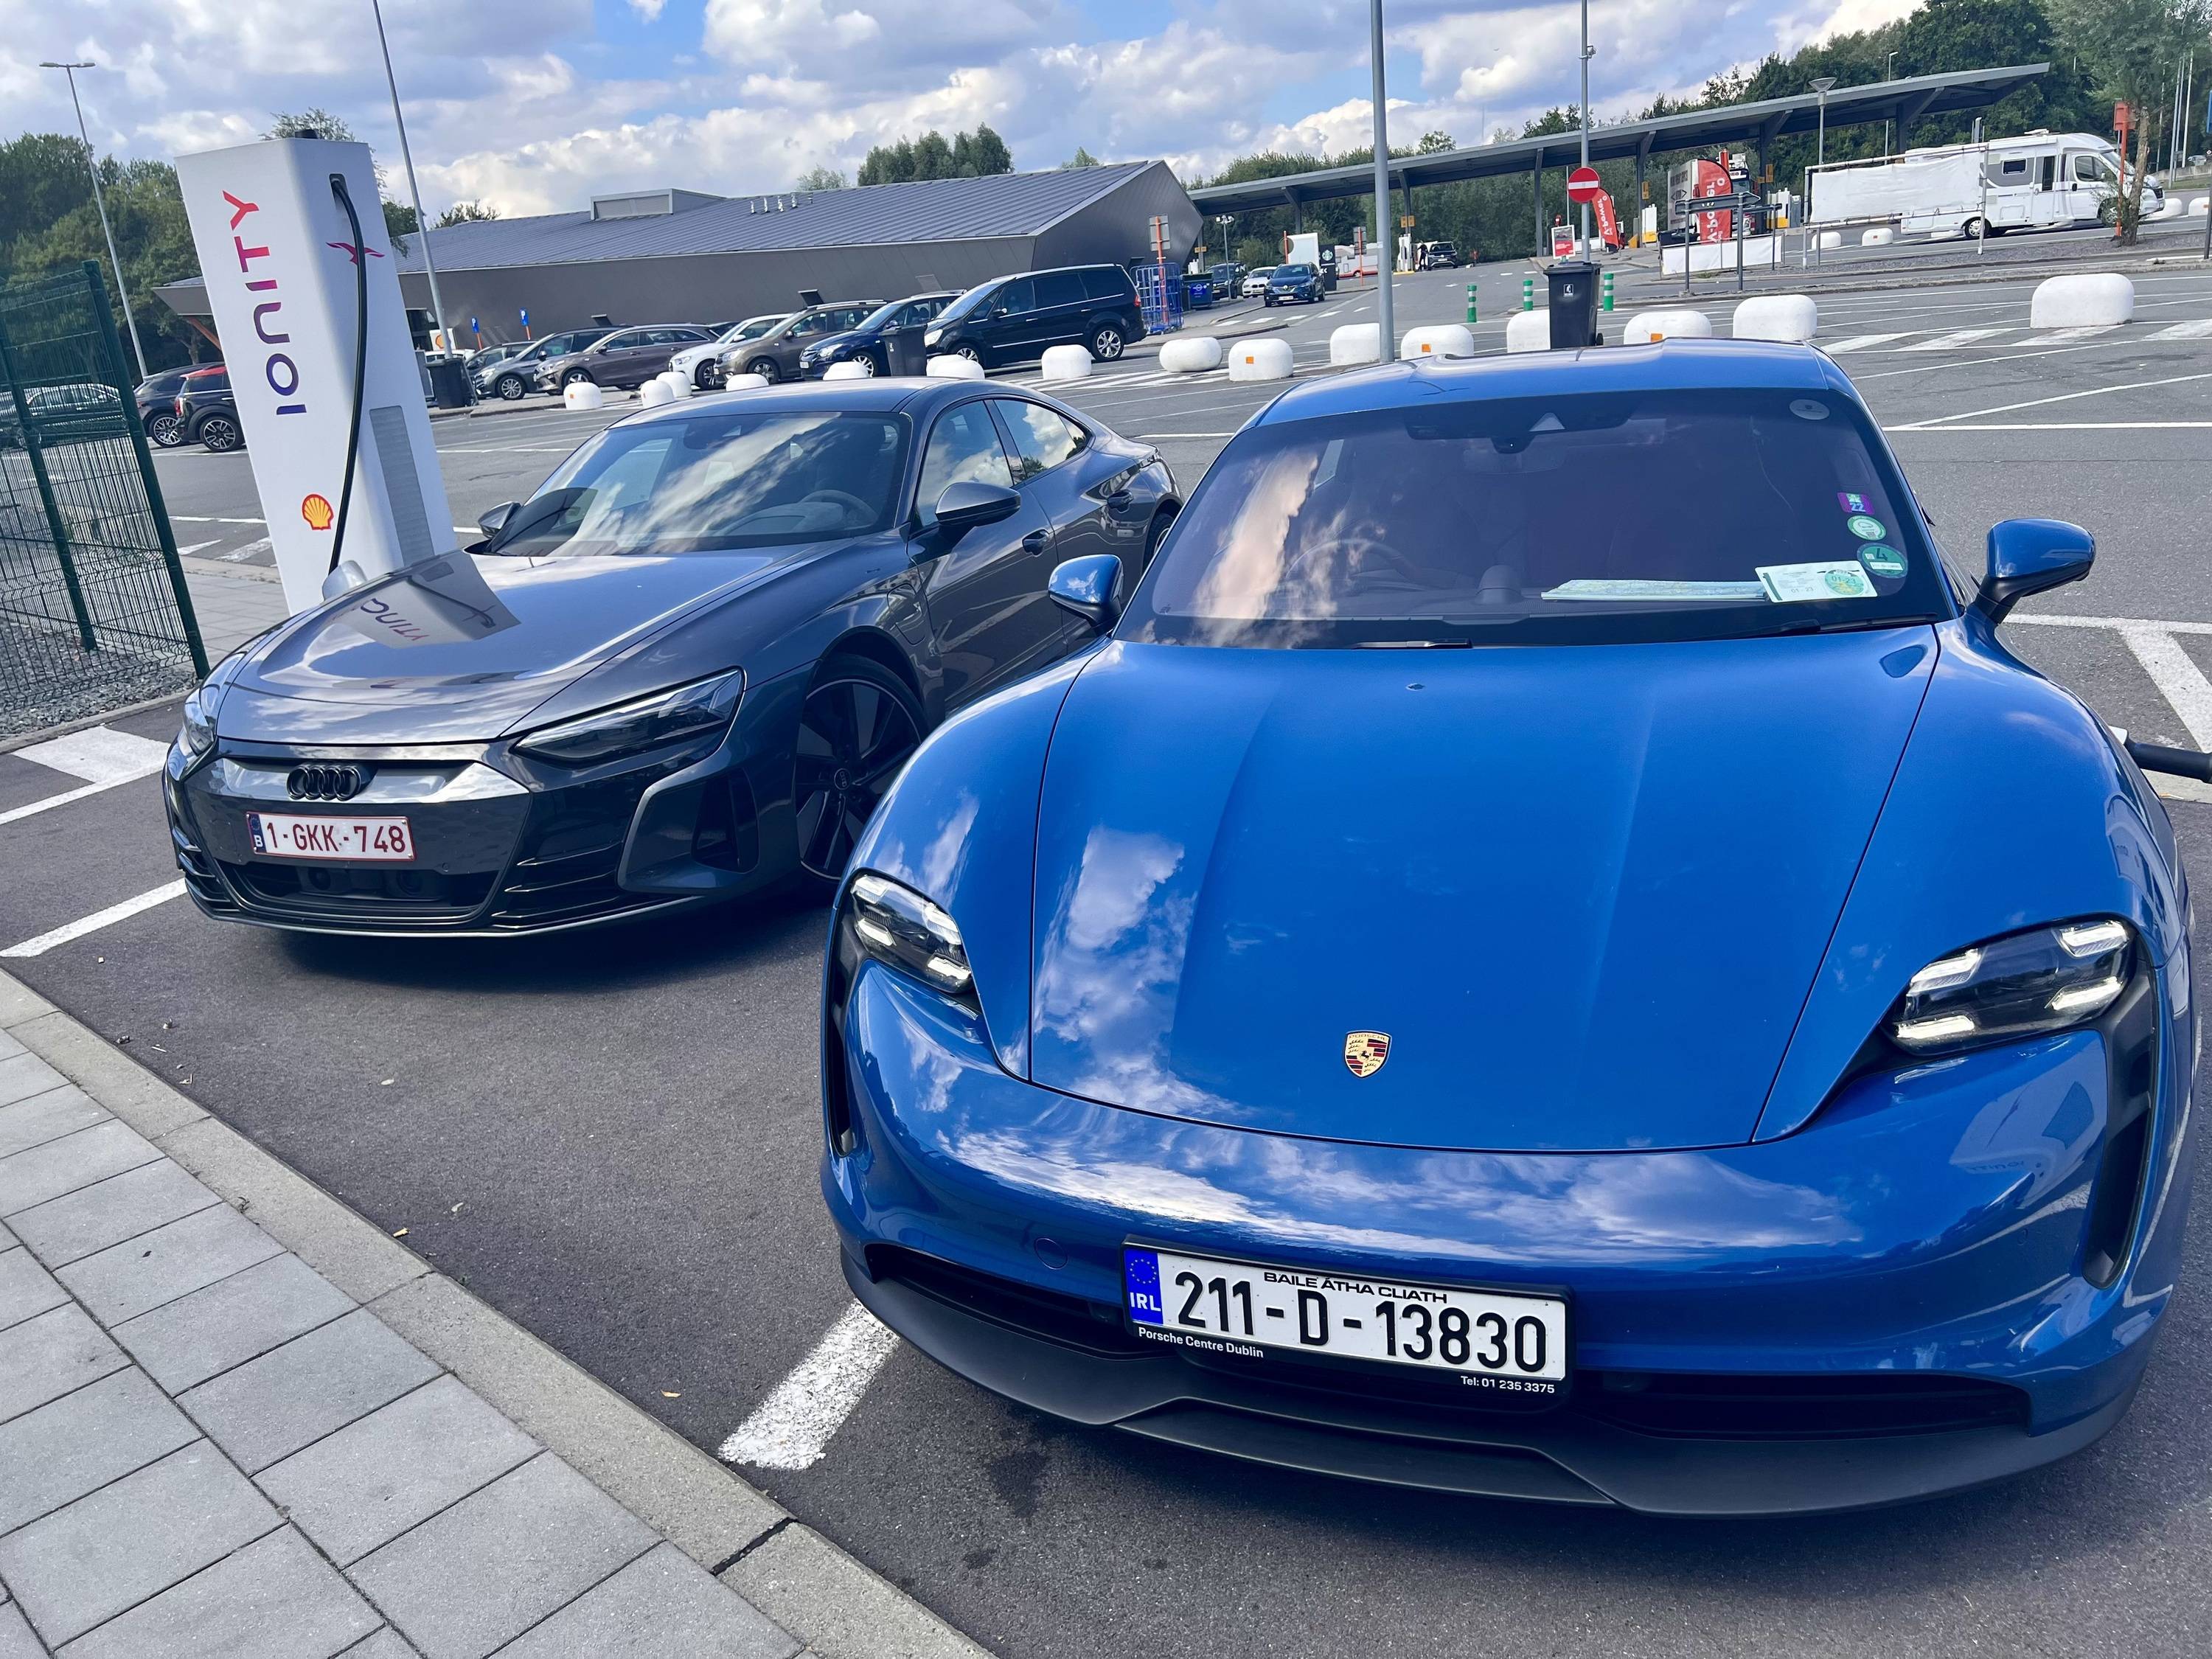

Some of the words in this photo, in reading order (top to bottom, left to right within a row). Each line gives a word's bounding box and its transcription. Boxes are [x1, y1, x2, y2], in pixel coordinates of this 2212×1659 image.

[223, 190, 307, 415] IONITY
[254, 835, 263, 848] B
[267, 822, 406, 853] 1-GKK-748
[1130, 1292, 1161, 1312] IRL
[1264, 1272, 1318, 1288] BAILE
[1321, 1278, 1375, 1295] ÁTHA
[1378, 1286, 1447, 1304] CLIATH
[1175, 1271, 1546, 1372] 211-D-13830
[1138, 1326, 1183, 1344] Porsche
[1186, 1335, 1224, 1352] Centre
[1226, 1343, 1264, 1358] Dublin
[1461, 1376, 1480, 1387] Tel:
[1481, 1378, 1495, 1388] 01
[1499, 1380, 1522, 1391] 235
[1524, 1382, 1555, 1394] 3375
